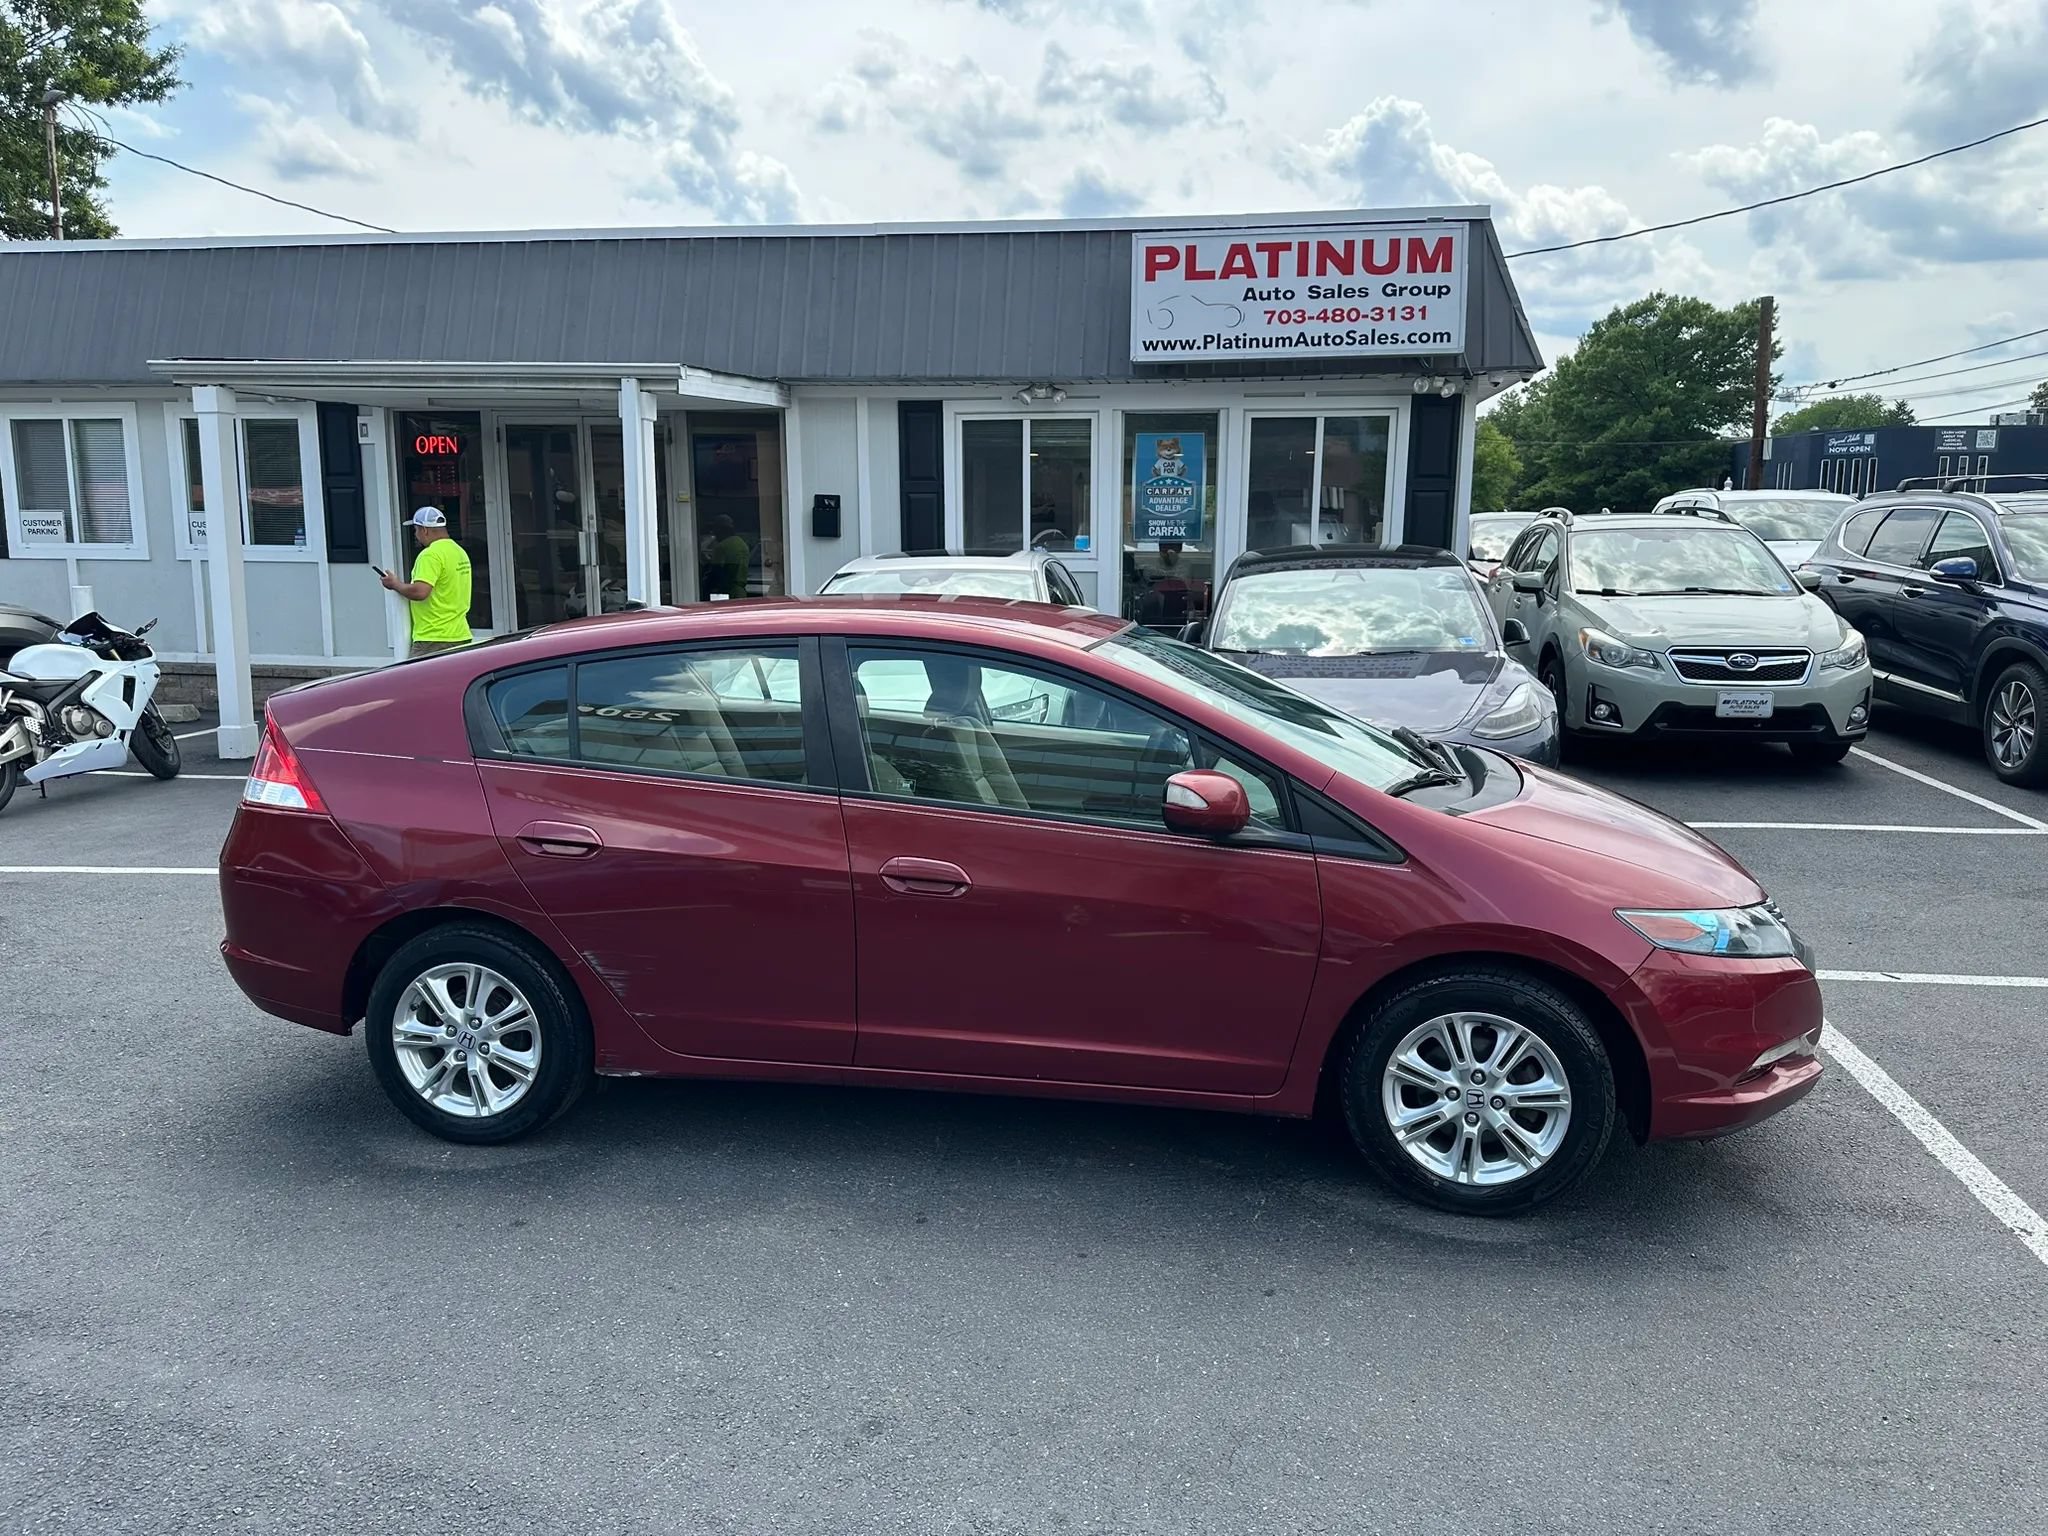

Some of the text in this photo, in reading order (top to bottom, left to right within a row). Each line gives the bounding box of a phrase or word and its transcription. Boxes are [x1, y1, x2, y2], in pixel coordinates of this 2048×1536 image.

[1145, 236, 1453, 282] PLATINUM
[1242, 282, 1452, 302] Auto Sales Group
[1263, 305, 1428, 326] 703-480-3131
[1142, 328, 1452, 352] www.PlatinumAutoSales.com
[415, 435, 458, 454] OPEN
[1828, 445, 1871, 454] NOW OPEN
[1146, 487, 1192, 496] CARFAX
[1148, 496, 1188, 504] ADVANTAGE
[1155, 504, 1181, 512] DEALER
[22, 518, 63, 528] CUSTOMER
[1148, 519, 1186, 527] SHOW ME THE
[27, 527, 59, 536] PARKING
[1148, 526, 1187, 537] CARFAX
